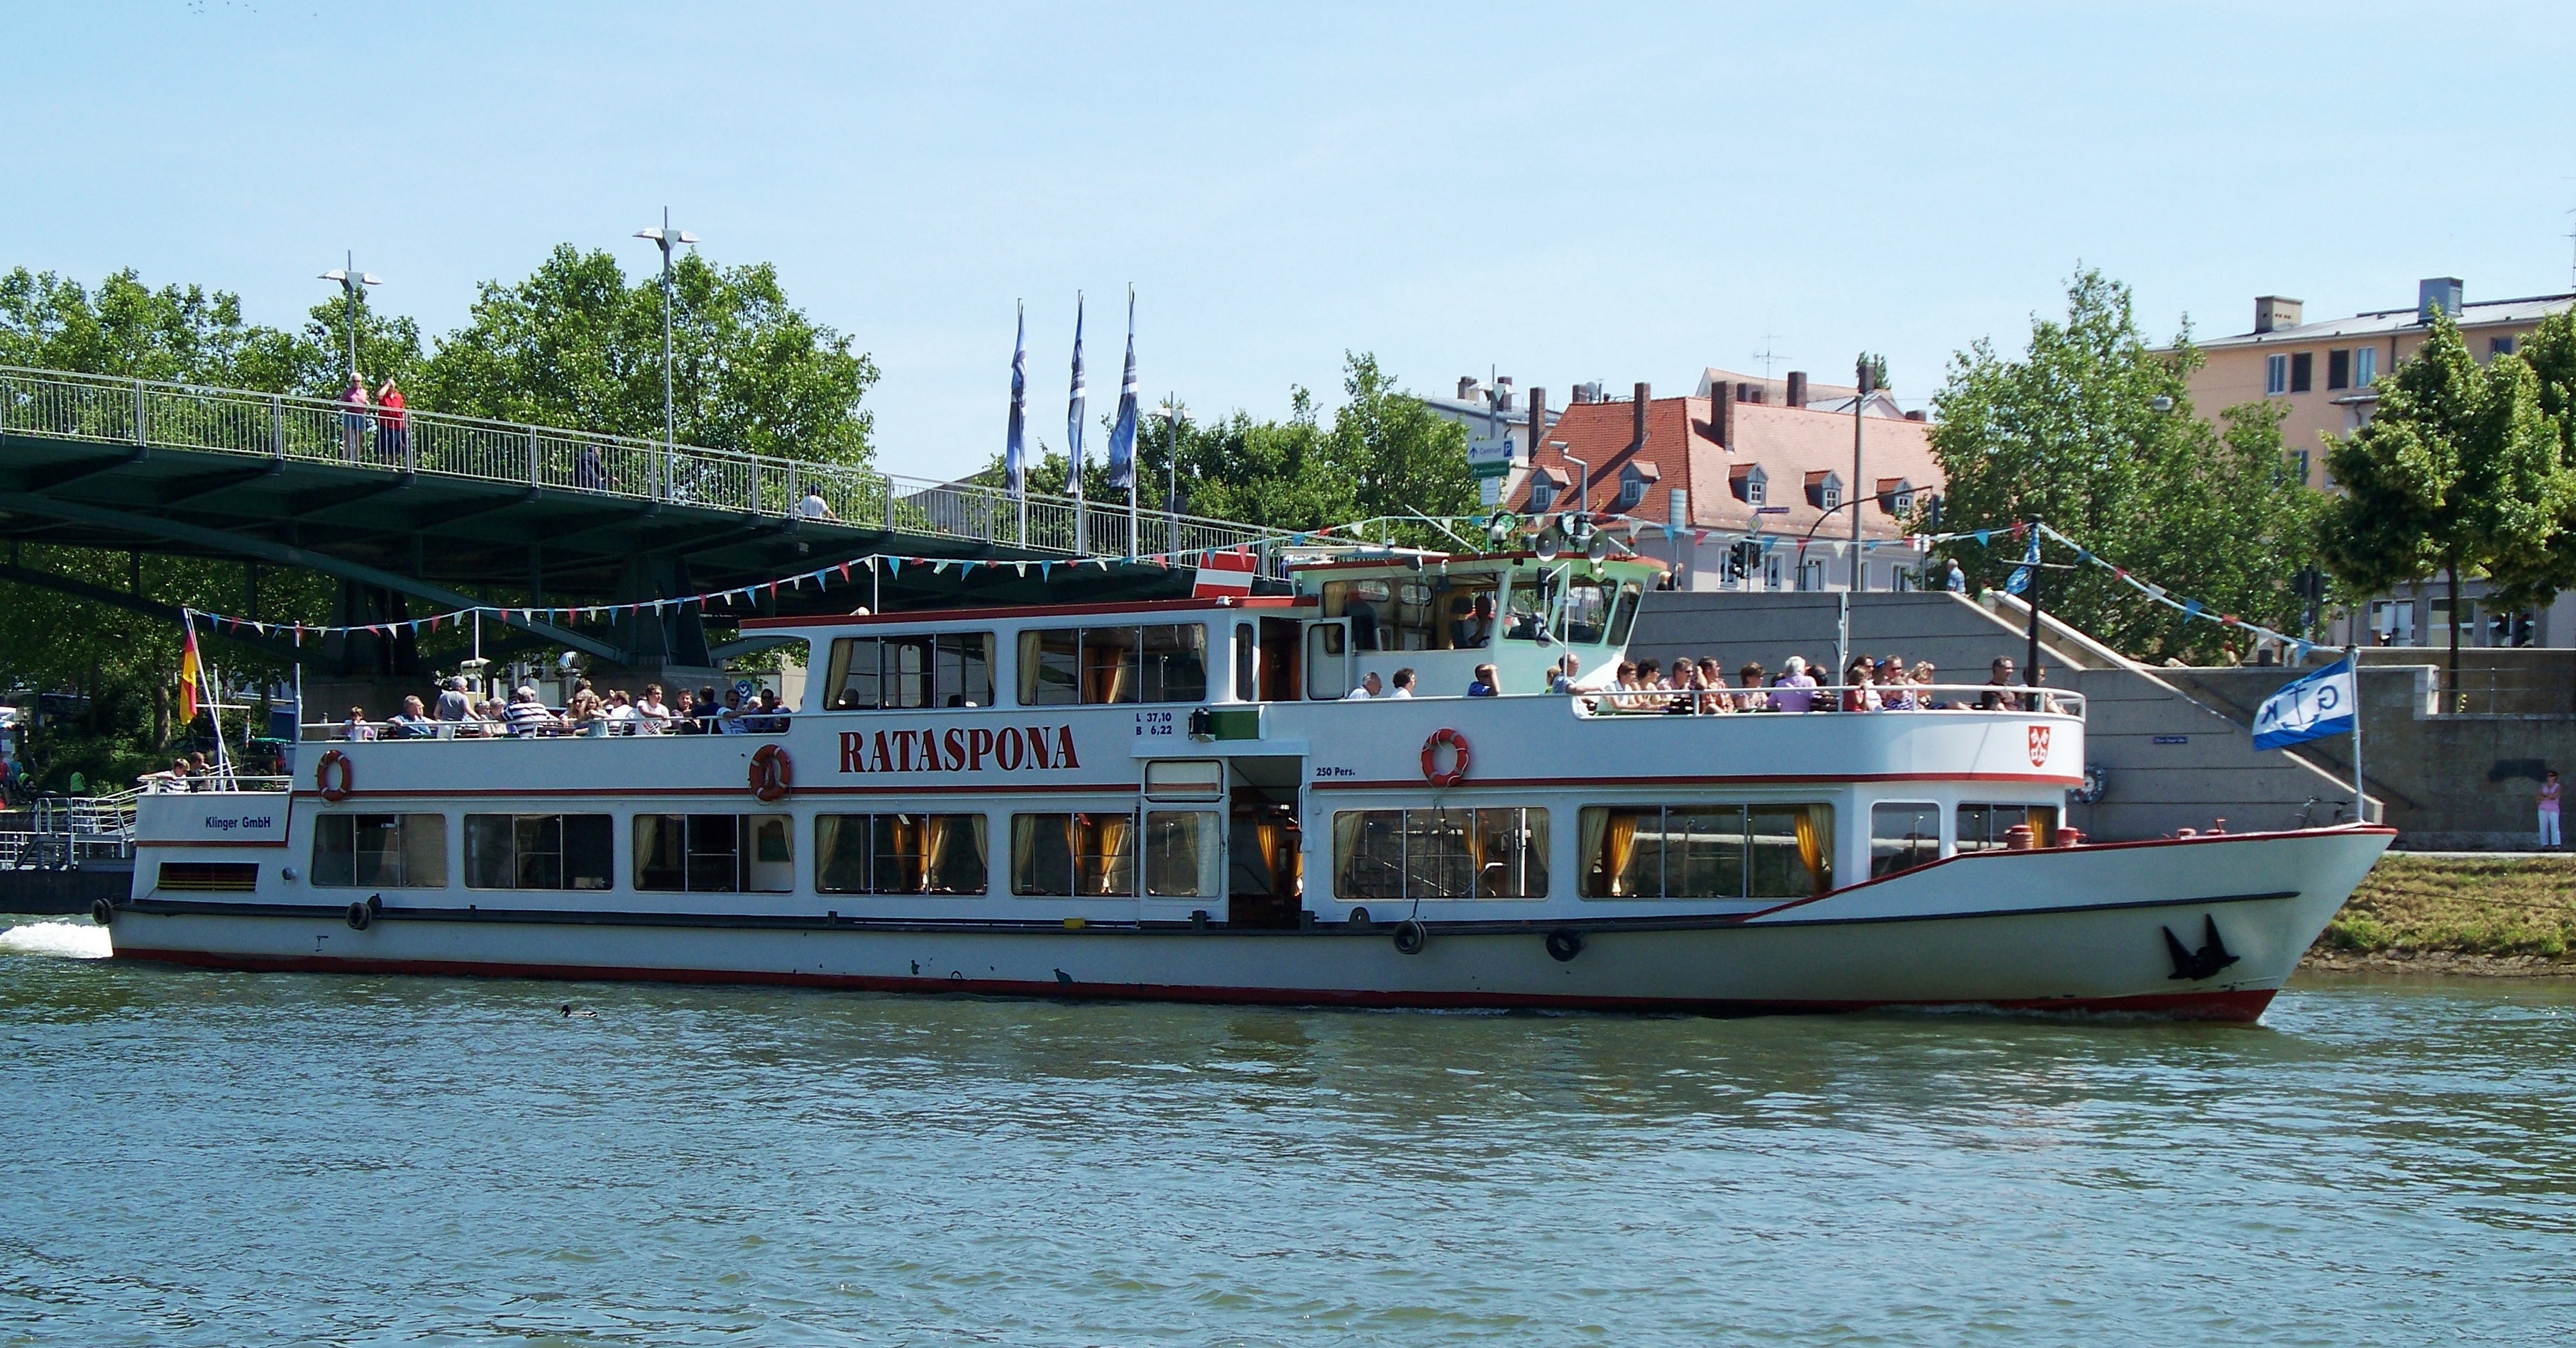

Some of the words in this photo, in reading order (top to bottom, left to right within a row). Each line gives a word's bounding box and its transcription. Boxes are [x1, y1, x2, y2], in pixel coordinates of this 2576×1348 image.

[1136, 713, 1141, 722] L
[1147, 712, 1172, 723] 37,10
[1136, 726, 1142, 735] B
[1151, 725, 1172, 736] 6,22
[839, 724, 1081, 773] RATASPONA
[1316, 767, 1332, 776] 250
[1335, 767, 1355, 776] Pers.
[206, 817, 238, 831] Klinger
[242, 817, 271, 828] GmbH
